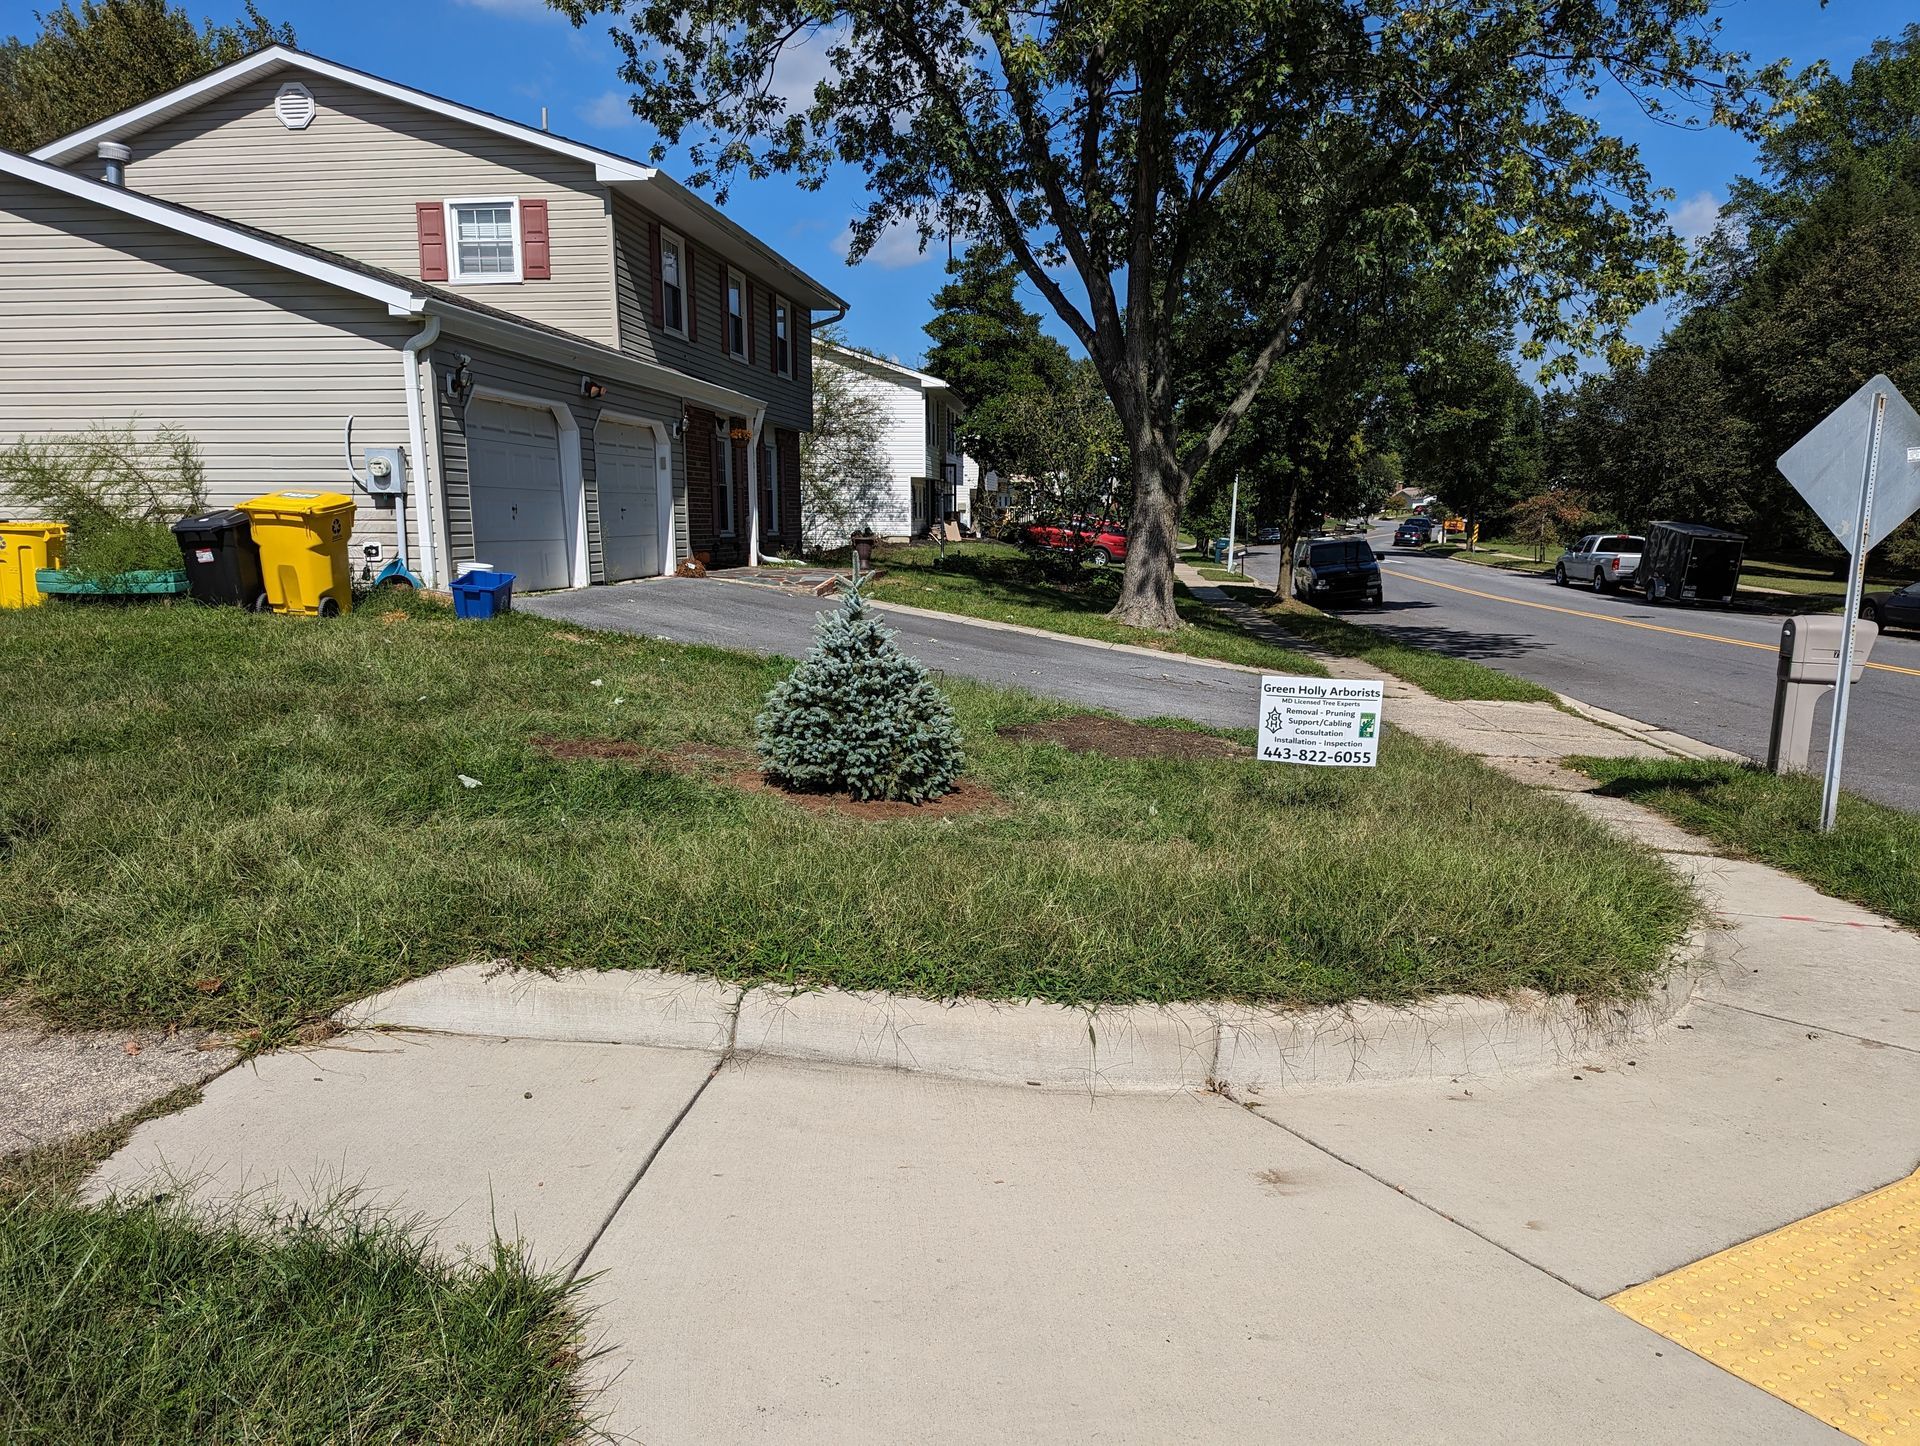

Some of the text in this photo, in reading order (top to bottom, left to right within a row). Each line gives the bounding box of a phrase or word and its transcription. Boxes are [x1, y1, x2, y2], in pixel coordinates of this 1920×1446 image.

[1264, 684, 1381, 698] Green Holly Arborists
[1286, 708, 1318, 716] Removal
[1326, 710, 1356, 718] Pruning
[1288, 718, 1352, 728] Support/Cabling
[1295, 728, 1343, 737] Consultation
[1274, 737, 1317, 746] Installation
[1324, 740, 1363, 748] Inspection
[1264, 746, 1371, 763] 443-822-6055
